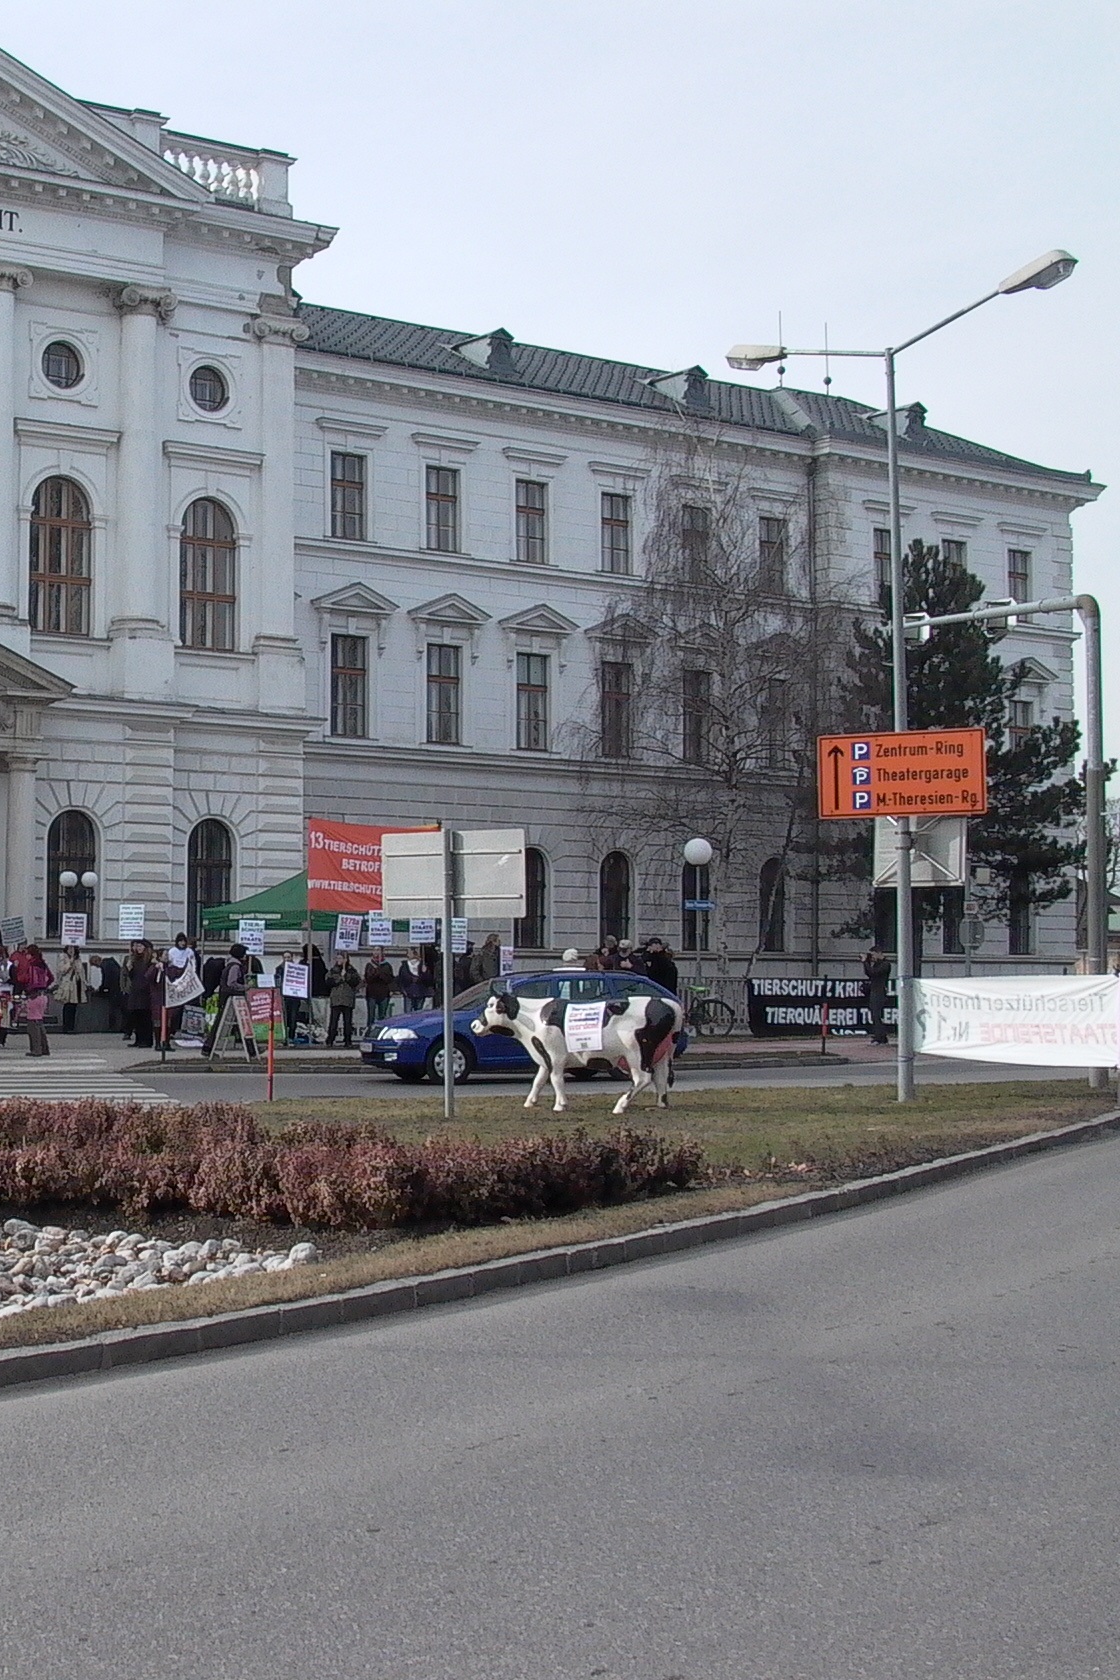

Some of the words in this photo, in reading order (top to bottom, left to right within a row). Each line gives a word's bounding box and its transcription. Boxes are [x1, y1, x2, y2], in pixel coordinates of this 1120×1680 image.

[875, 740, 964, 758] Zentrum-Ring
[876, 766, 969, 783] Theatergarage
[341, 858, 383, 872] BETROF
[339, 930, 358, 941] alle!
[765, 1004, 858, 1026] TIERQUÄLEREI
